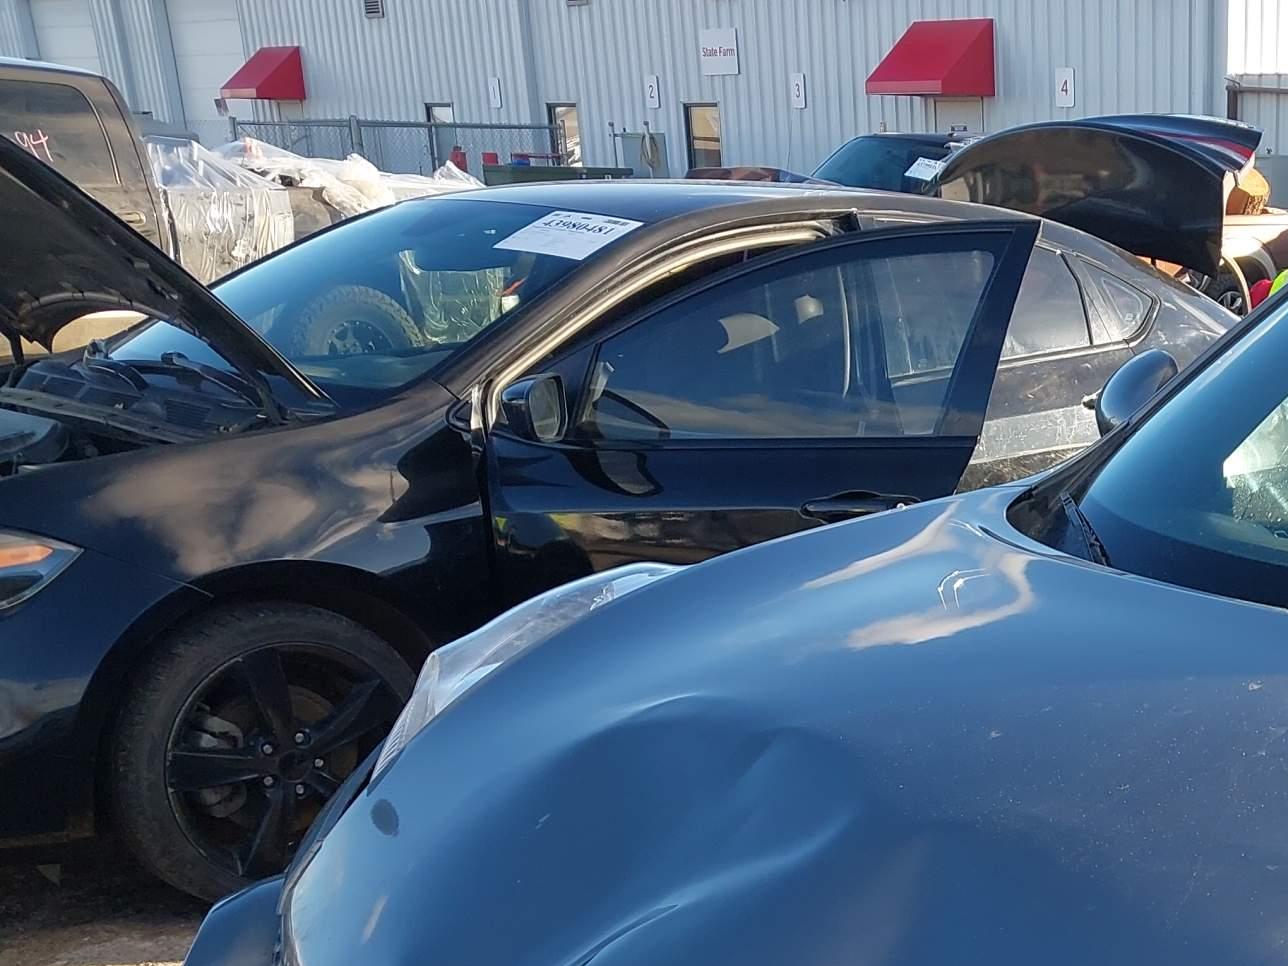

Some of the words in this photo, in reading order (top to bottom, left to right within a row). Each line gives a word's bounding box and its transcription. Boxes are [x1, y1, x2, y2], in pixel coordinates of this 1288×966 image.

[702, 46, 718, 57] State
[718, 46, 736, 57] Farm
[648, 84, 654, 99] 2
[795, 83, 801, 98] 3
[1060, 79, 1068, 96] 4
